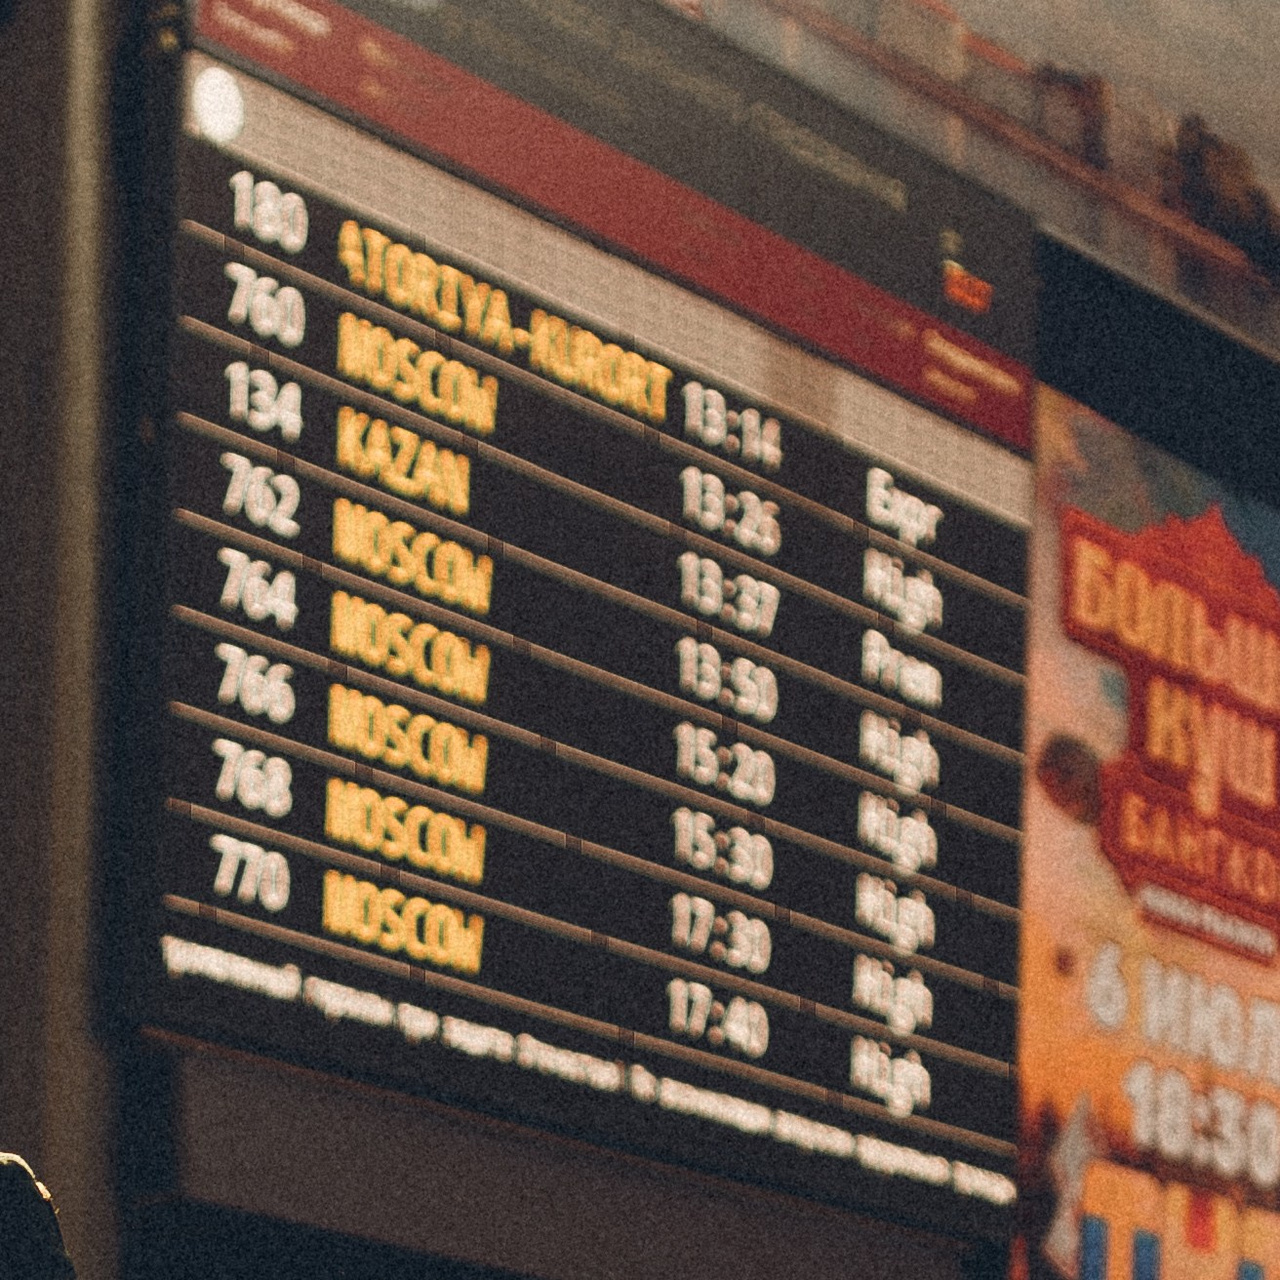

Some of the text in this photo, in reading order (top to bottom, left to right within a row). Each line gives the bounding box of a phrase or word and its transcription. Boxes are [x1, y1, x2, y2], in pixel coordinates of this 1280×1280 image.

[230, 171, 308, 252] 180
[226, 262, 305, 345] 760
[337, 312, 498, 433] MOSCOW
[223, 452, 300, 537] 762
[333, 498, 493, 614] MOSCOW
[226, 361, 302, 438] 134
[336, 406, 470, 514] KAZAN
[679, 551, 780, 637] 13:37
[217, 643, 295, 723] 766
[327, 683, 488, 793] MOSCOW
[673, 806, 774, 889] 15:30
[220, 547, 297, 628] 764
[330, 591, 490, 705] MOSCOW
[675, 721, 776, 805] 15:20
[211, 834, 290, 911] 770
[323, 870, 484, 973] MOSCOW
[668, 978, 769, 1058] 17:40
[214, 738, 292, 817] 768
[325, 778, 486, 884] MOSCOW
[671, 892, 772, 973] 17:30
